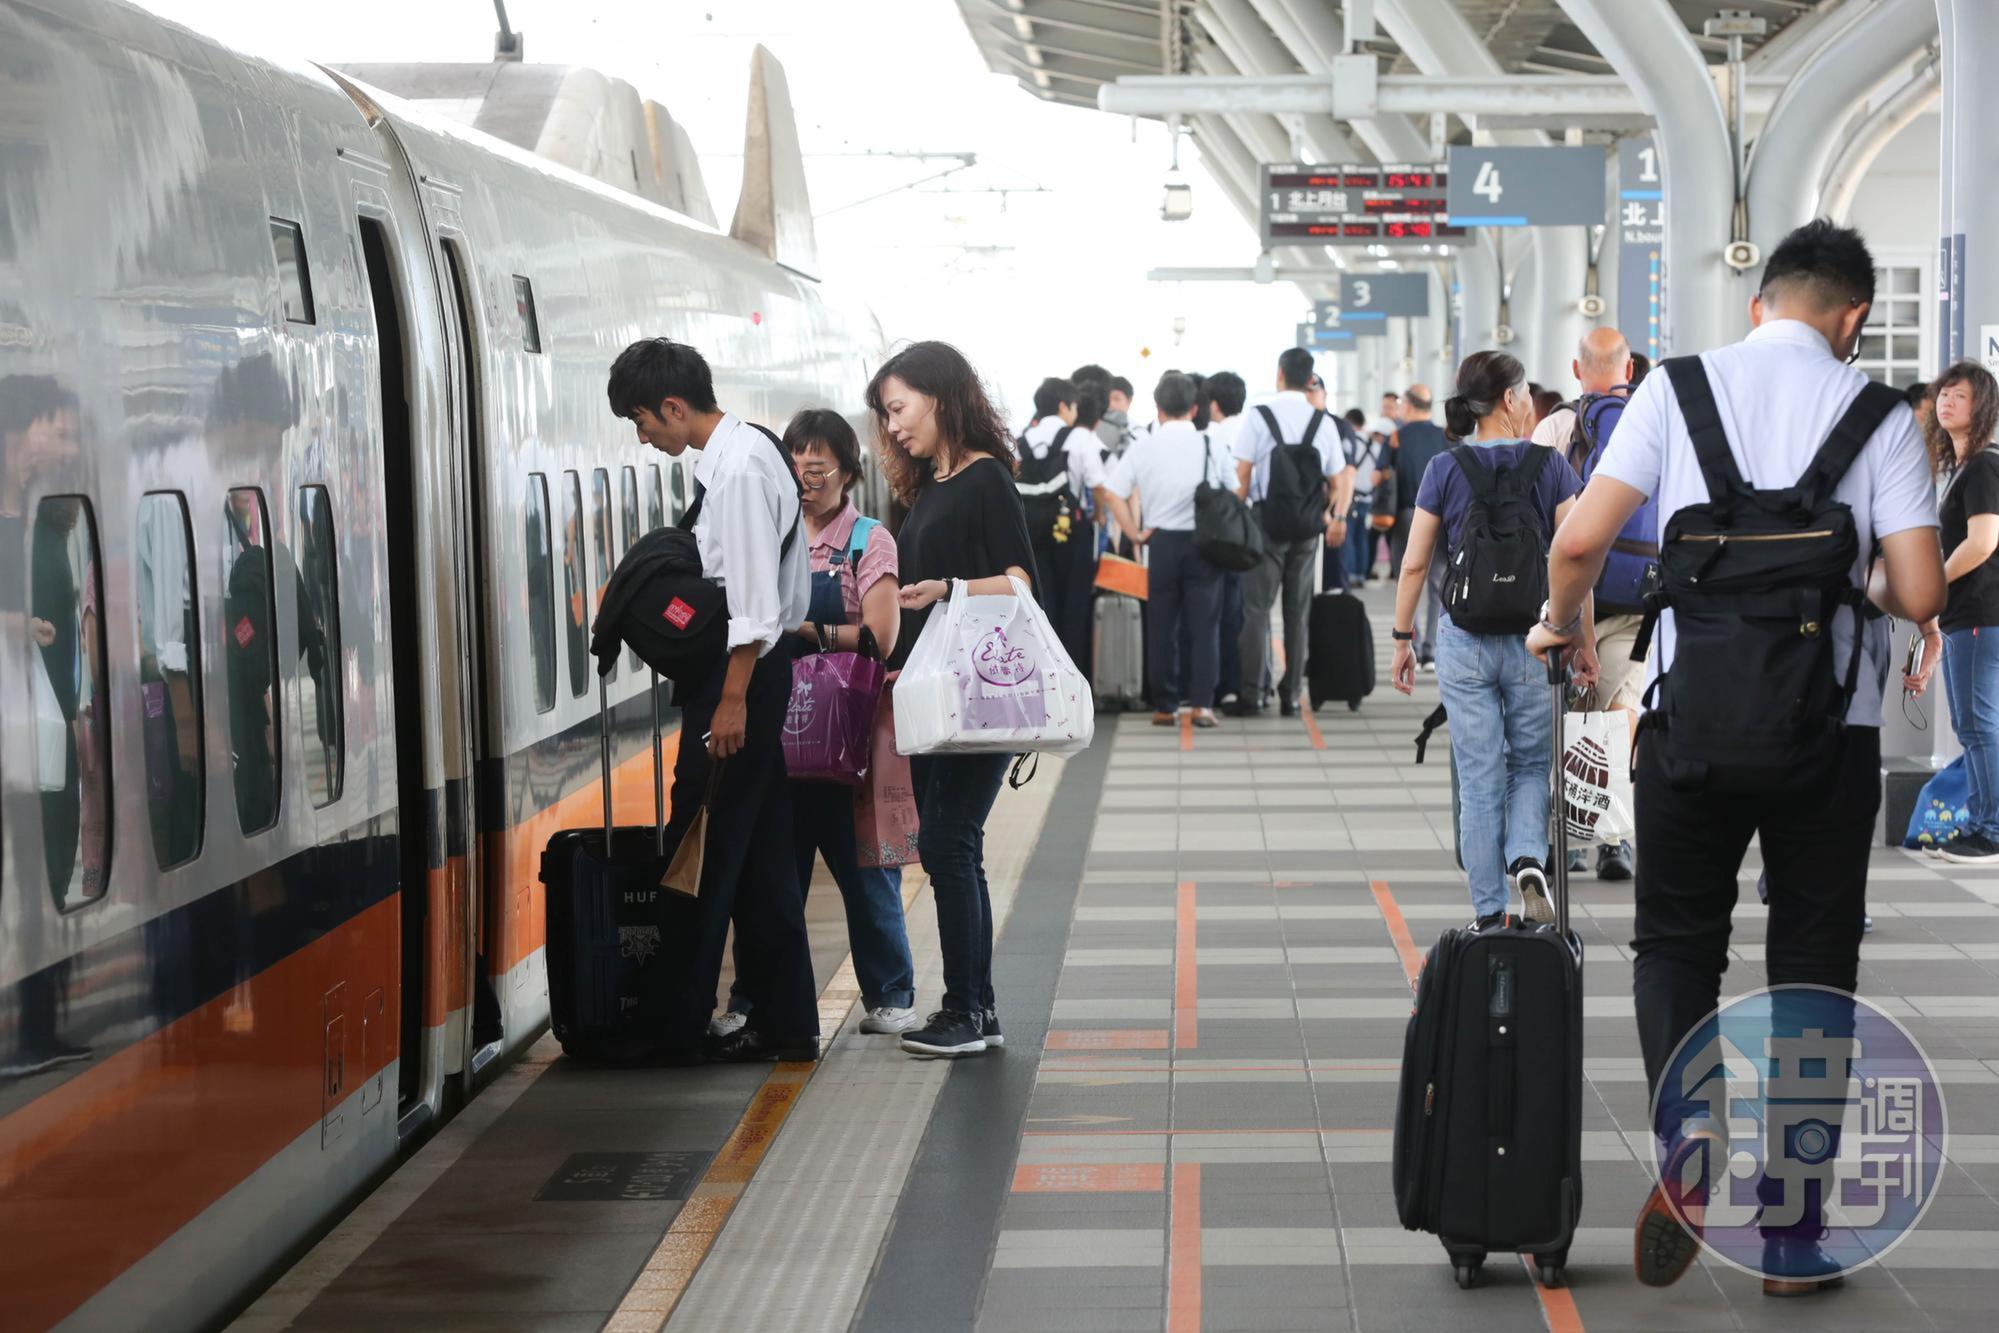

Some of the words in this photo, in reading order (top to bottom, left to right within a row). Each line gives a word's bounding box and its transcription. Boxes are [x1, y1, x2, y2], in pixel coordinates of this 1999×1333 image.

[1638, 147, 1659, 182] 1
[1472, 160, 1503, 204] 4
[1352, 280, 1372, 308] 3
[1324, 305, 1341, 328] 2
[1303, 326, 1317, 346] 1
[624, 891, 658, 903] HUF
